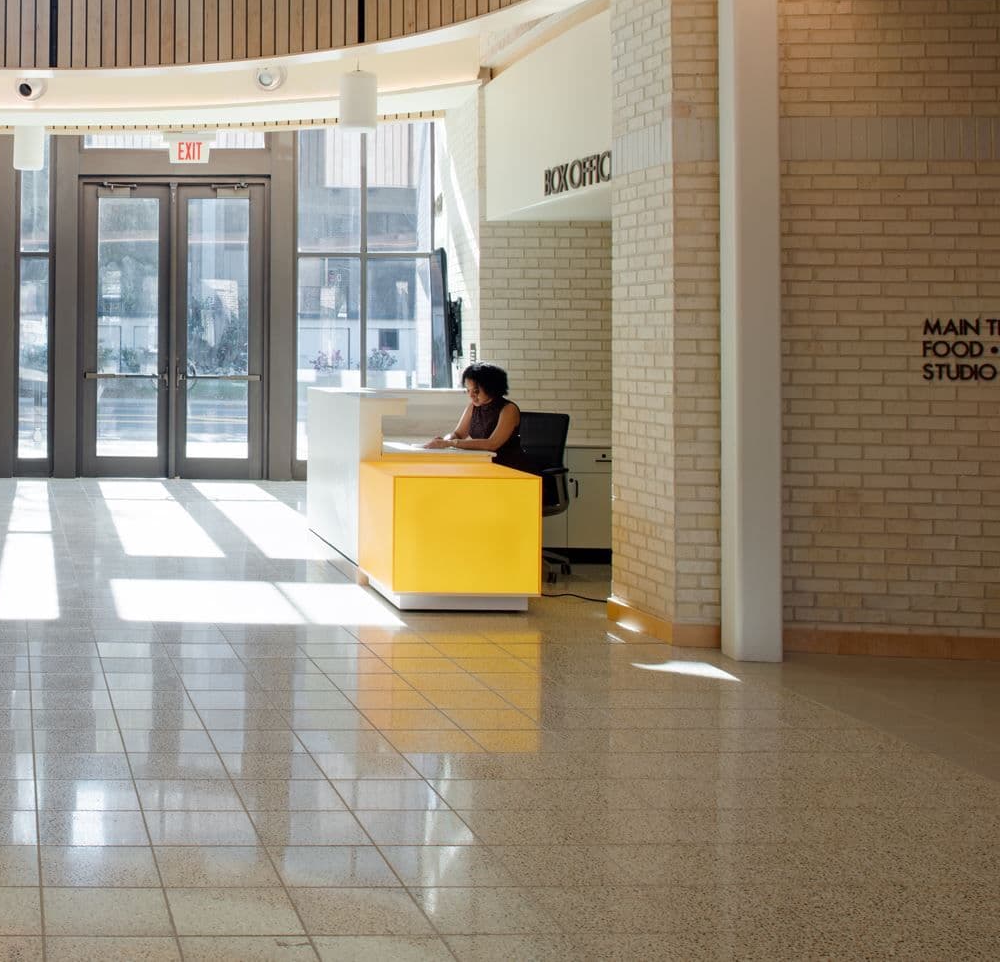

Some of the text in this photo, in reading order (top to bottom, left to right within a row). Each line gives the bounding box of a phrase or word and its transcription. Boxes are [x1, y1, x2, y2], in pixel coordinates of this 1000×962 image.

[177, 141, 202, 160] EXIT
[544, 150, 612, 196] BOX OFFIC
[923, 318, 1000, 335] MAIN T
[922, 340, 984, 358] FOOD
[922, 363, 997, 381] STUDIO
